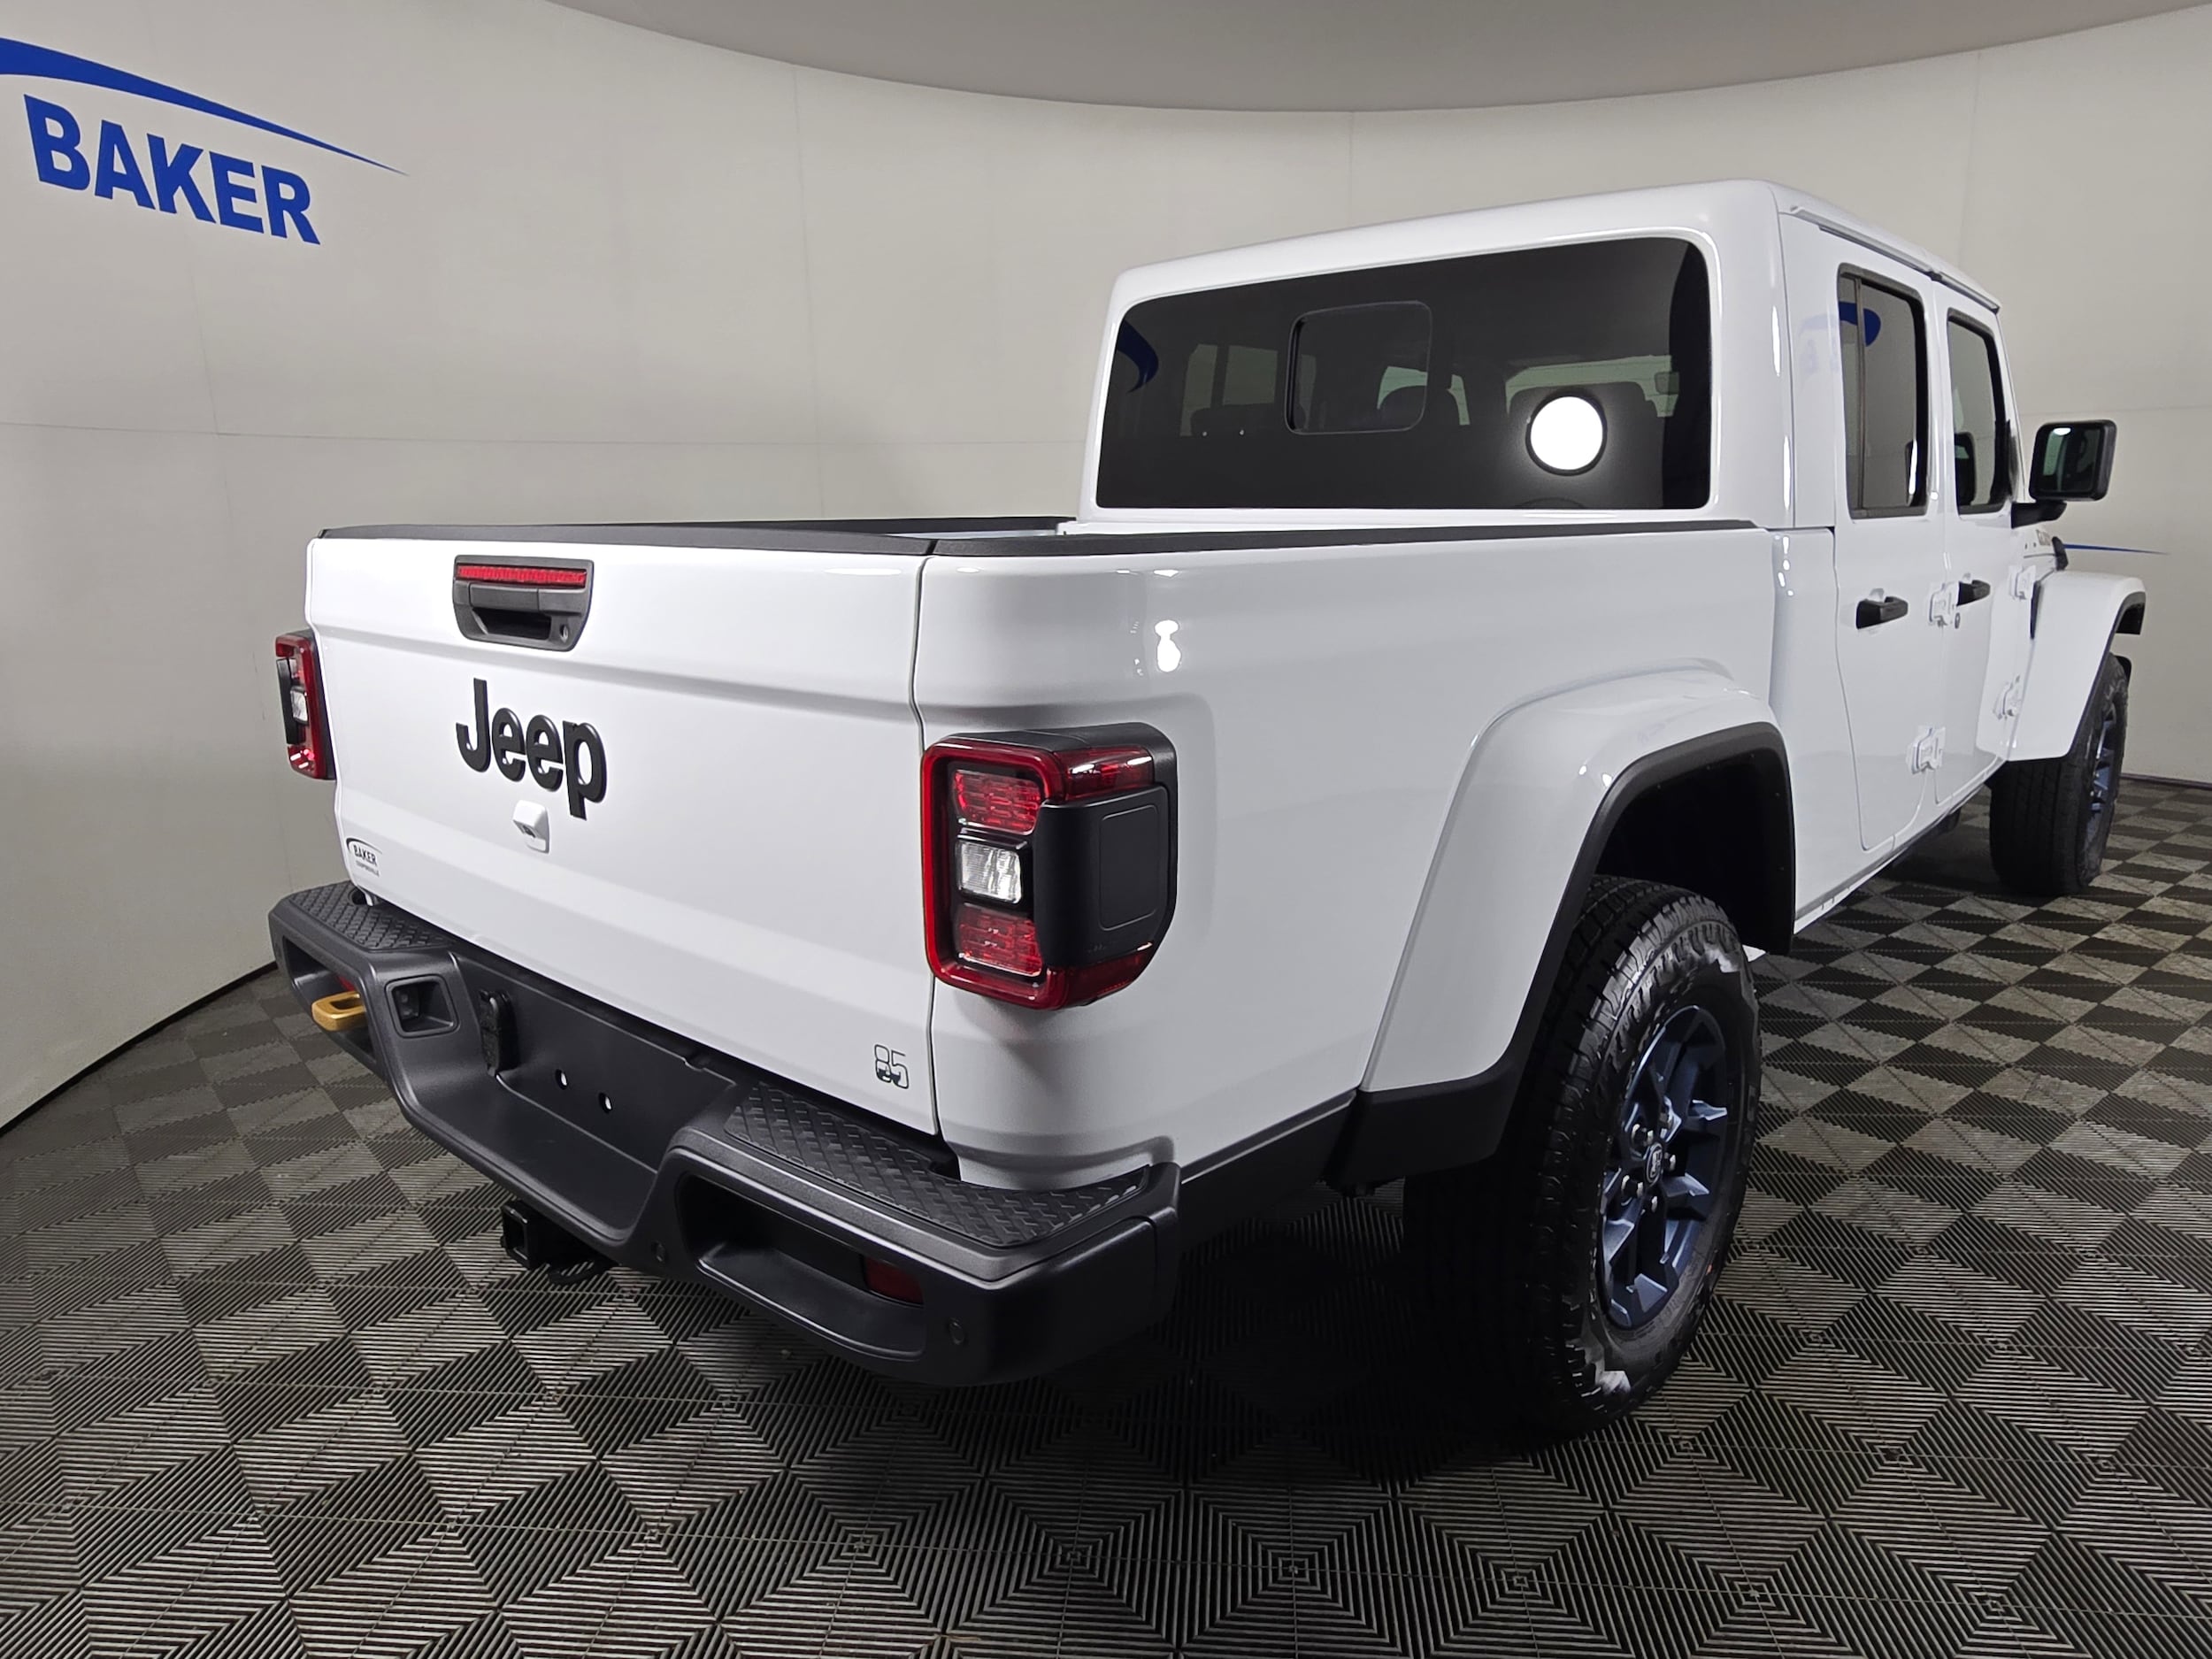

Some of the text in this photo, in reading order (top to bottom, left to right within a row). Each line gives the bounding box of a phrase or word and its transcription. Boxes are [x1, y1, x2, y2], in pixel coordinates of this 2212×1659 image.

[23, 93, 321, 245] BAKER
[455, 677, 607, 820] Jeep
[353, 844, 378, 866] BAKER
[874, 1044, 910, 1089] 85
